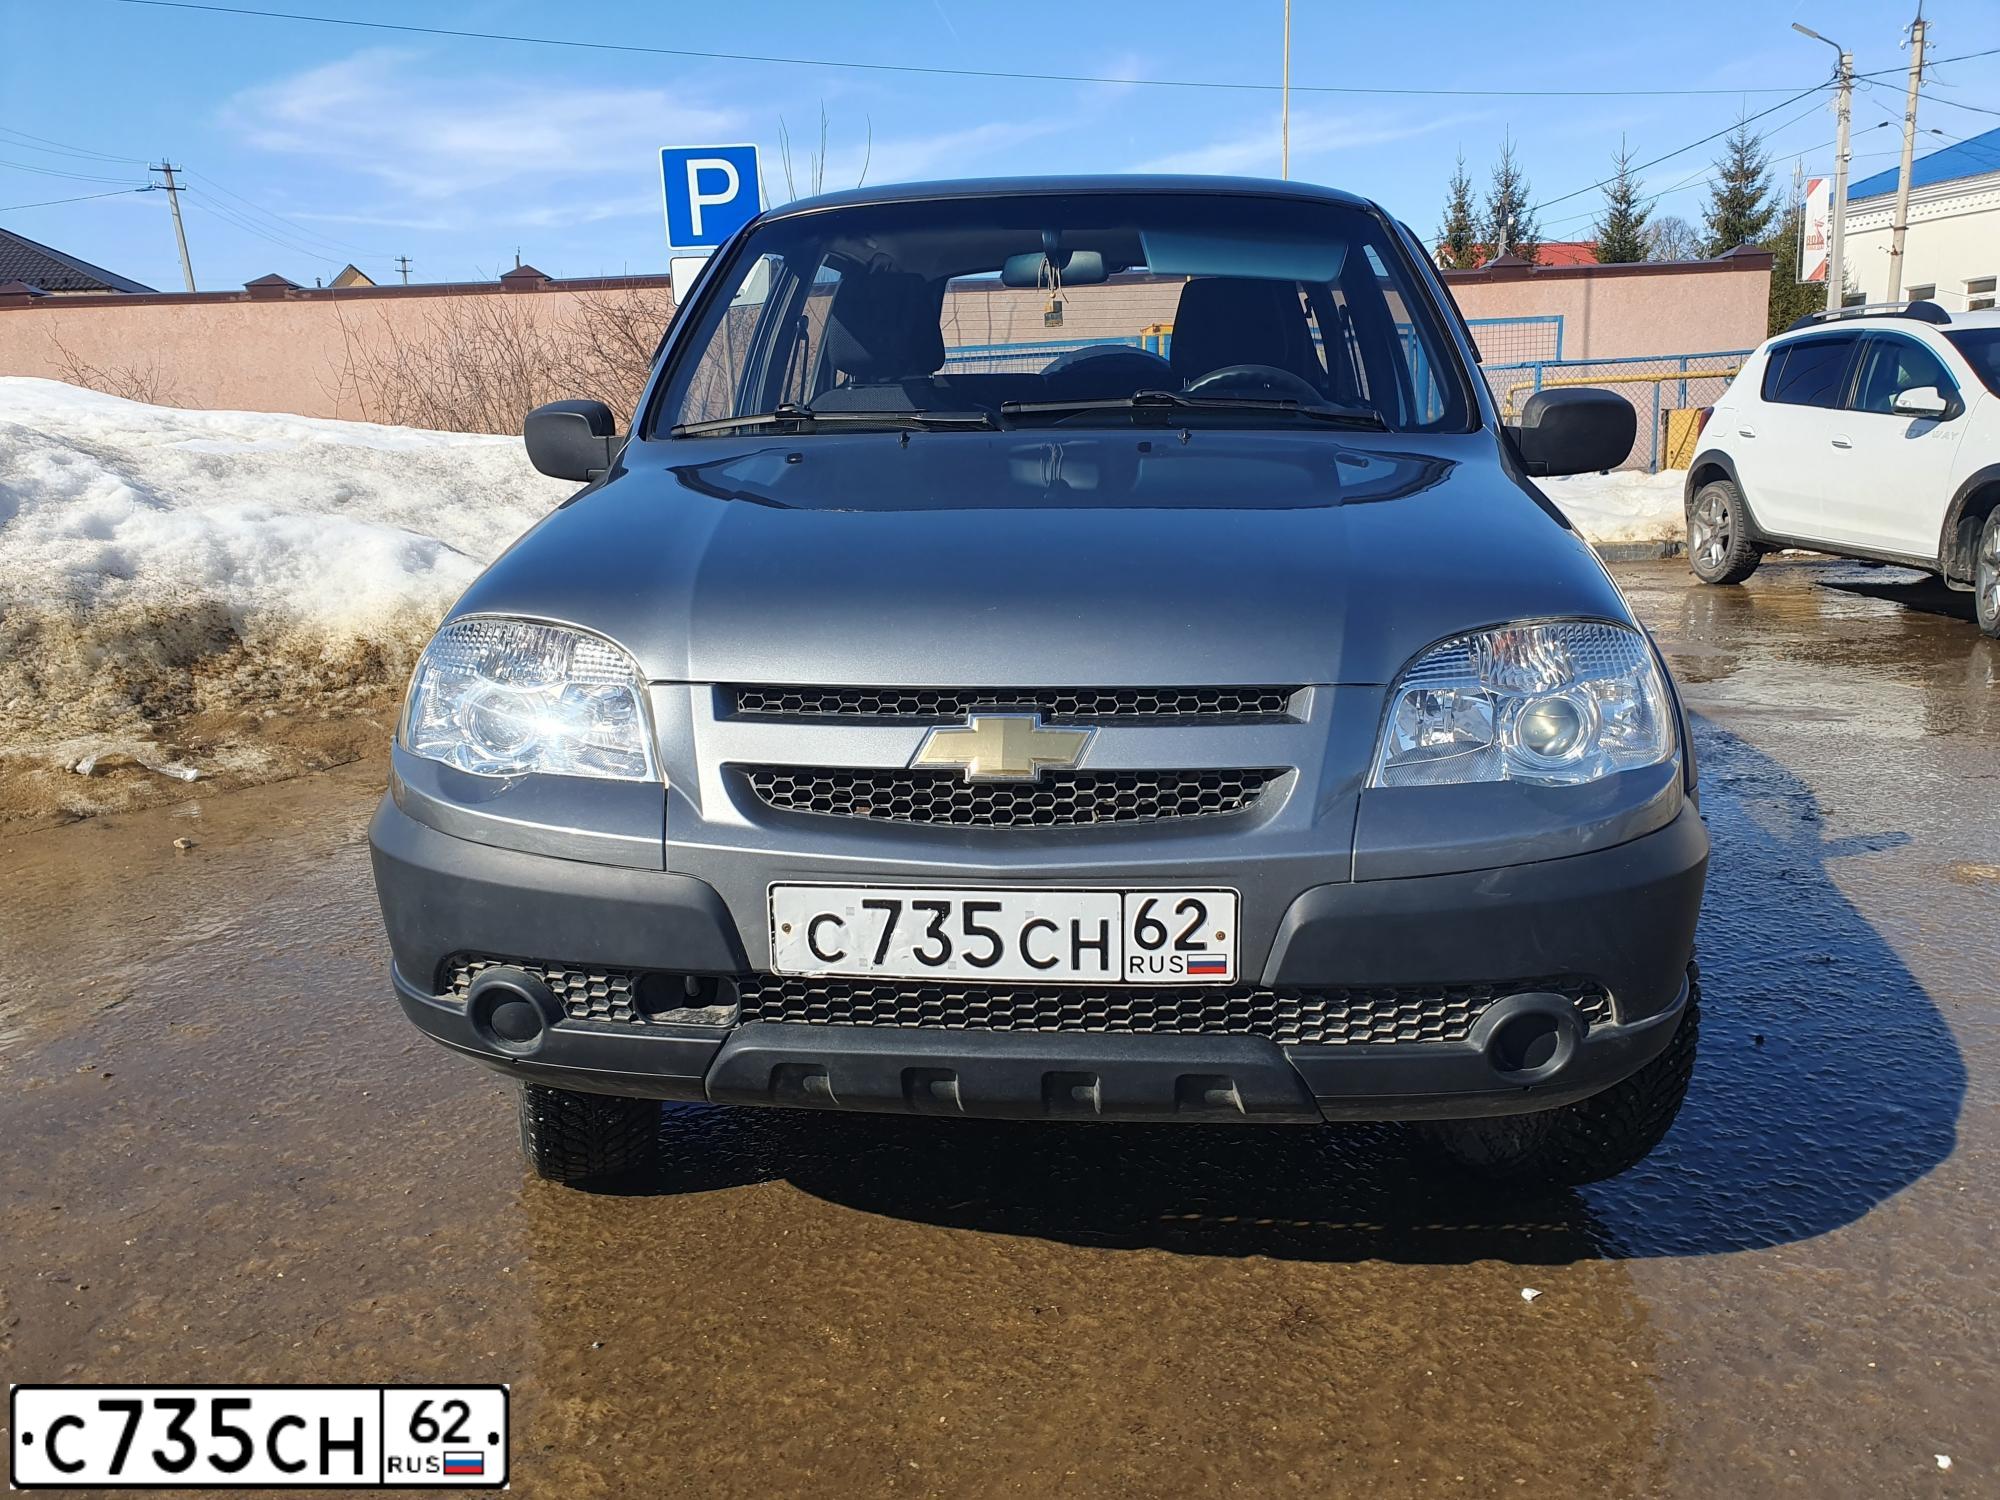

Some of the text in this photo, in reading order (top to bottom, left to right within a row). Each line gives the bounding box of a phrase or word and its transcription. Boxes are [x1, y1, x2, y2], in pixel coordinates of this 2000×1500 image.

[686, 158, 740, 236] P
[1134, 898, 1208, 951] 62
[1129, 955, 1184, 974] RUS
